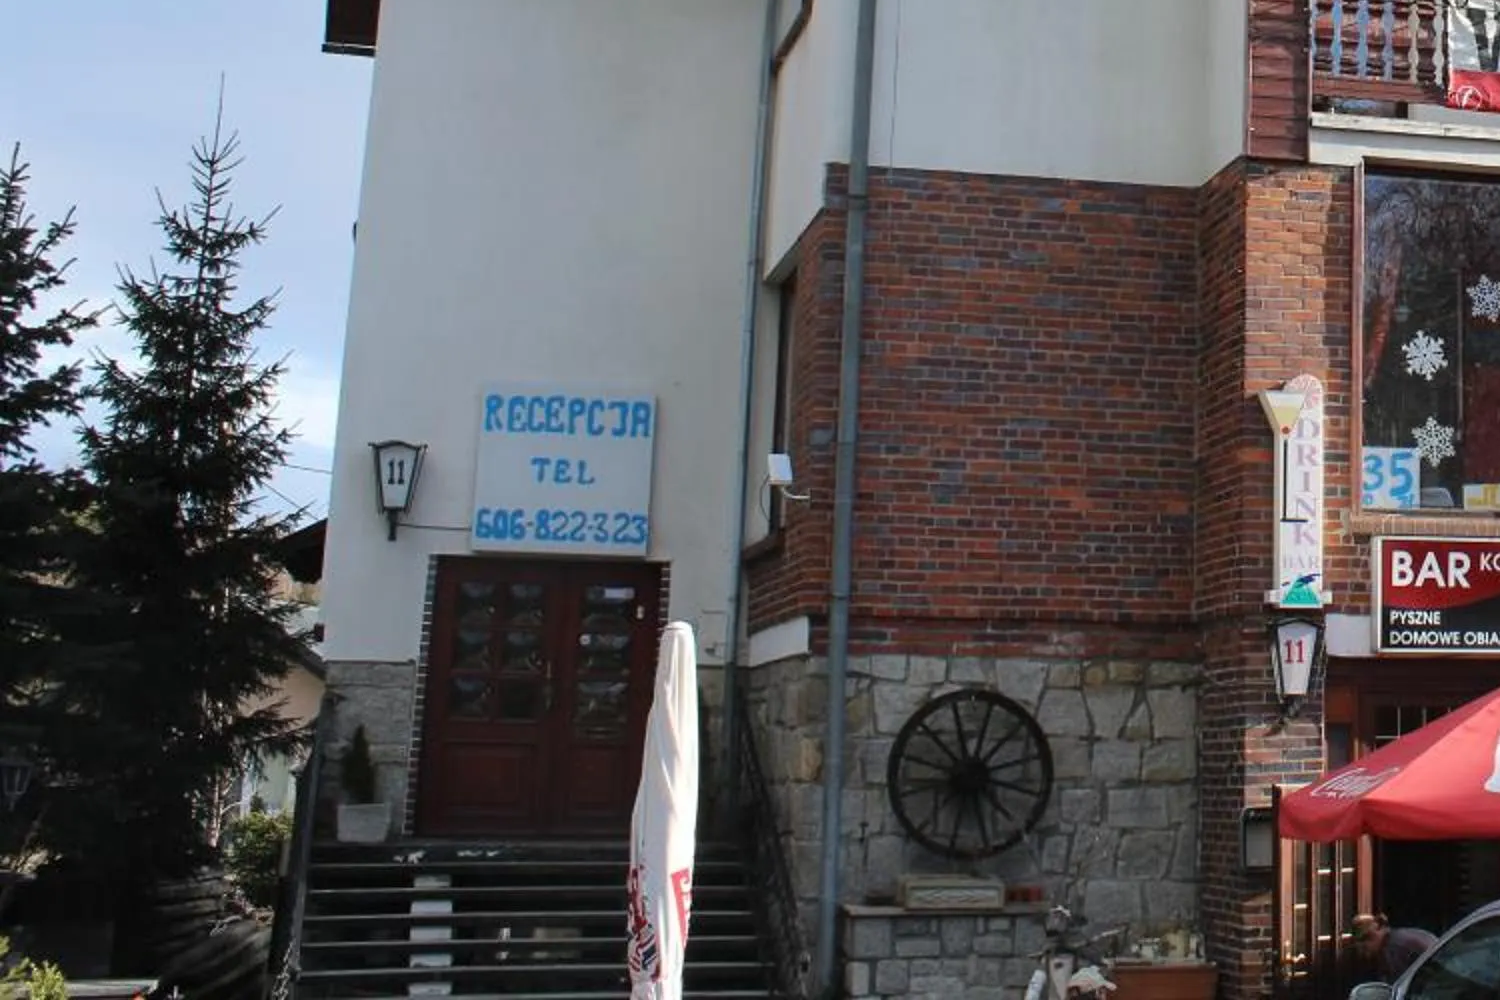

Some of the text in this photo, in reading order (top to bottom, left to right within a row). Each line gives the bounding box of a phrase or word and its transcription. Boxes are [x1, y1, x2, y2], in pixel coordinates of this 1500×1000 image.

[485, 394, 651, 438] RECEPCJA
[387, 459, 406, 485] 11
[531, 457, 595, 485] TEL
[1292, 417, 1321, 546] DRINK
[1363, 451, 1413, 497] 35
[475, 508, 648, 545] 606-822-323
[1391, 550, 1472, 589] BAR
[1390, 611, 1441, 625] PYSZNE
[1284, 639, 1306, 664] 11
[1390, 631, 1460, 646] DOMOWE
